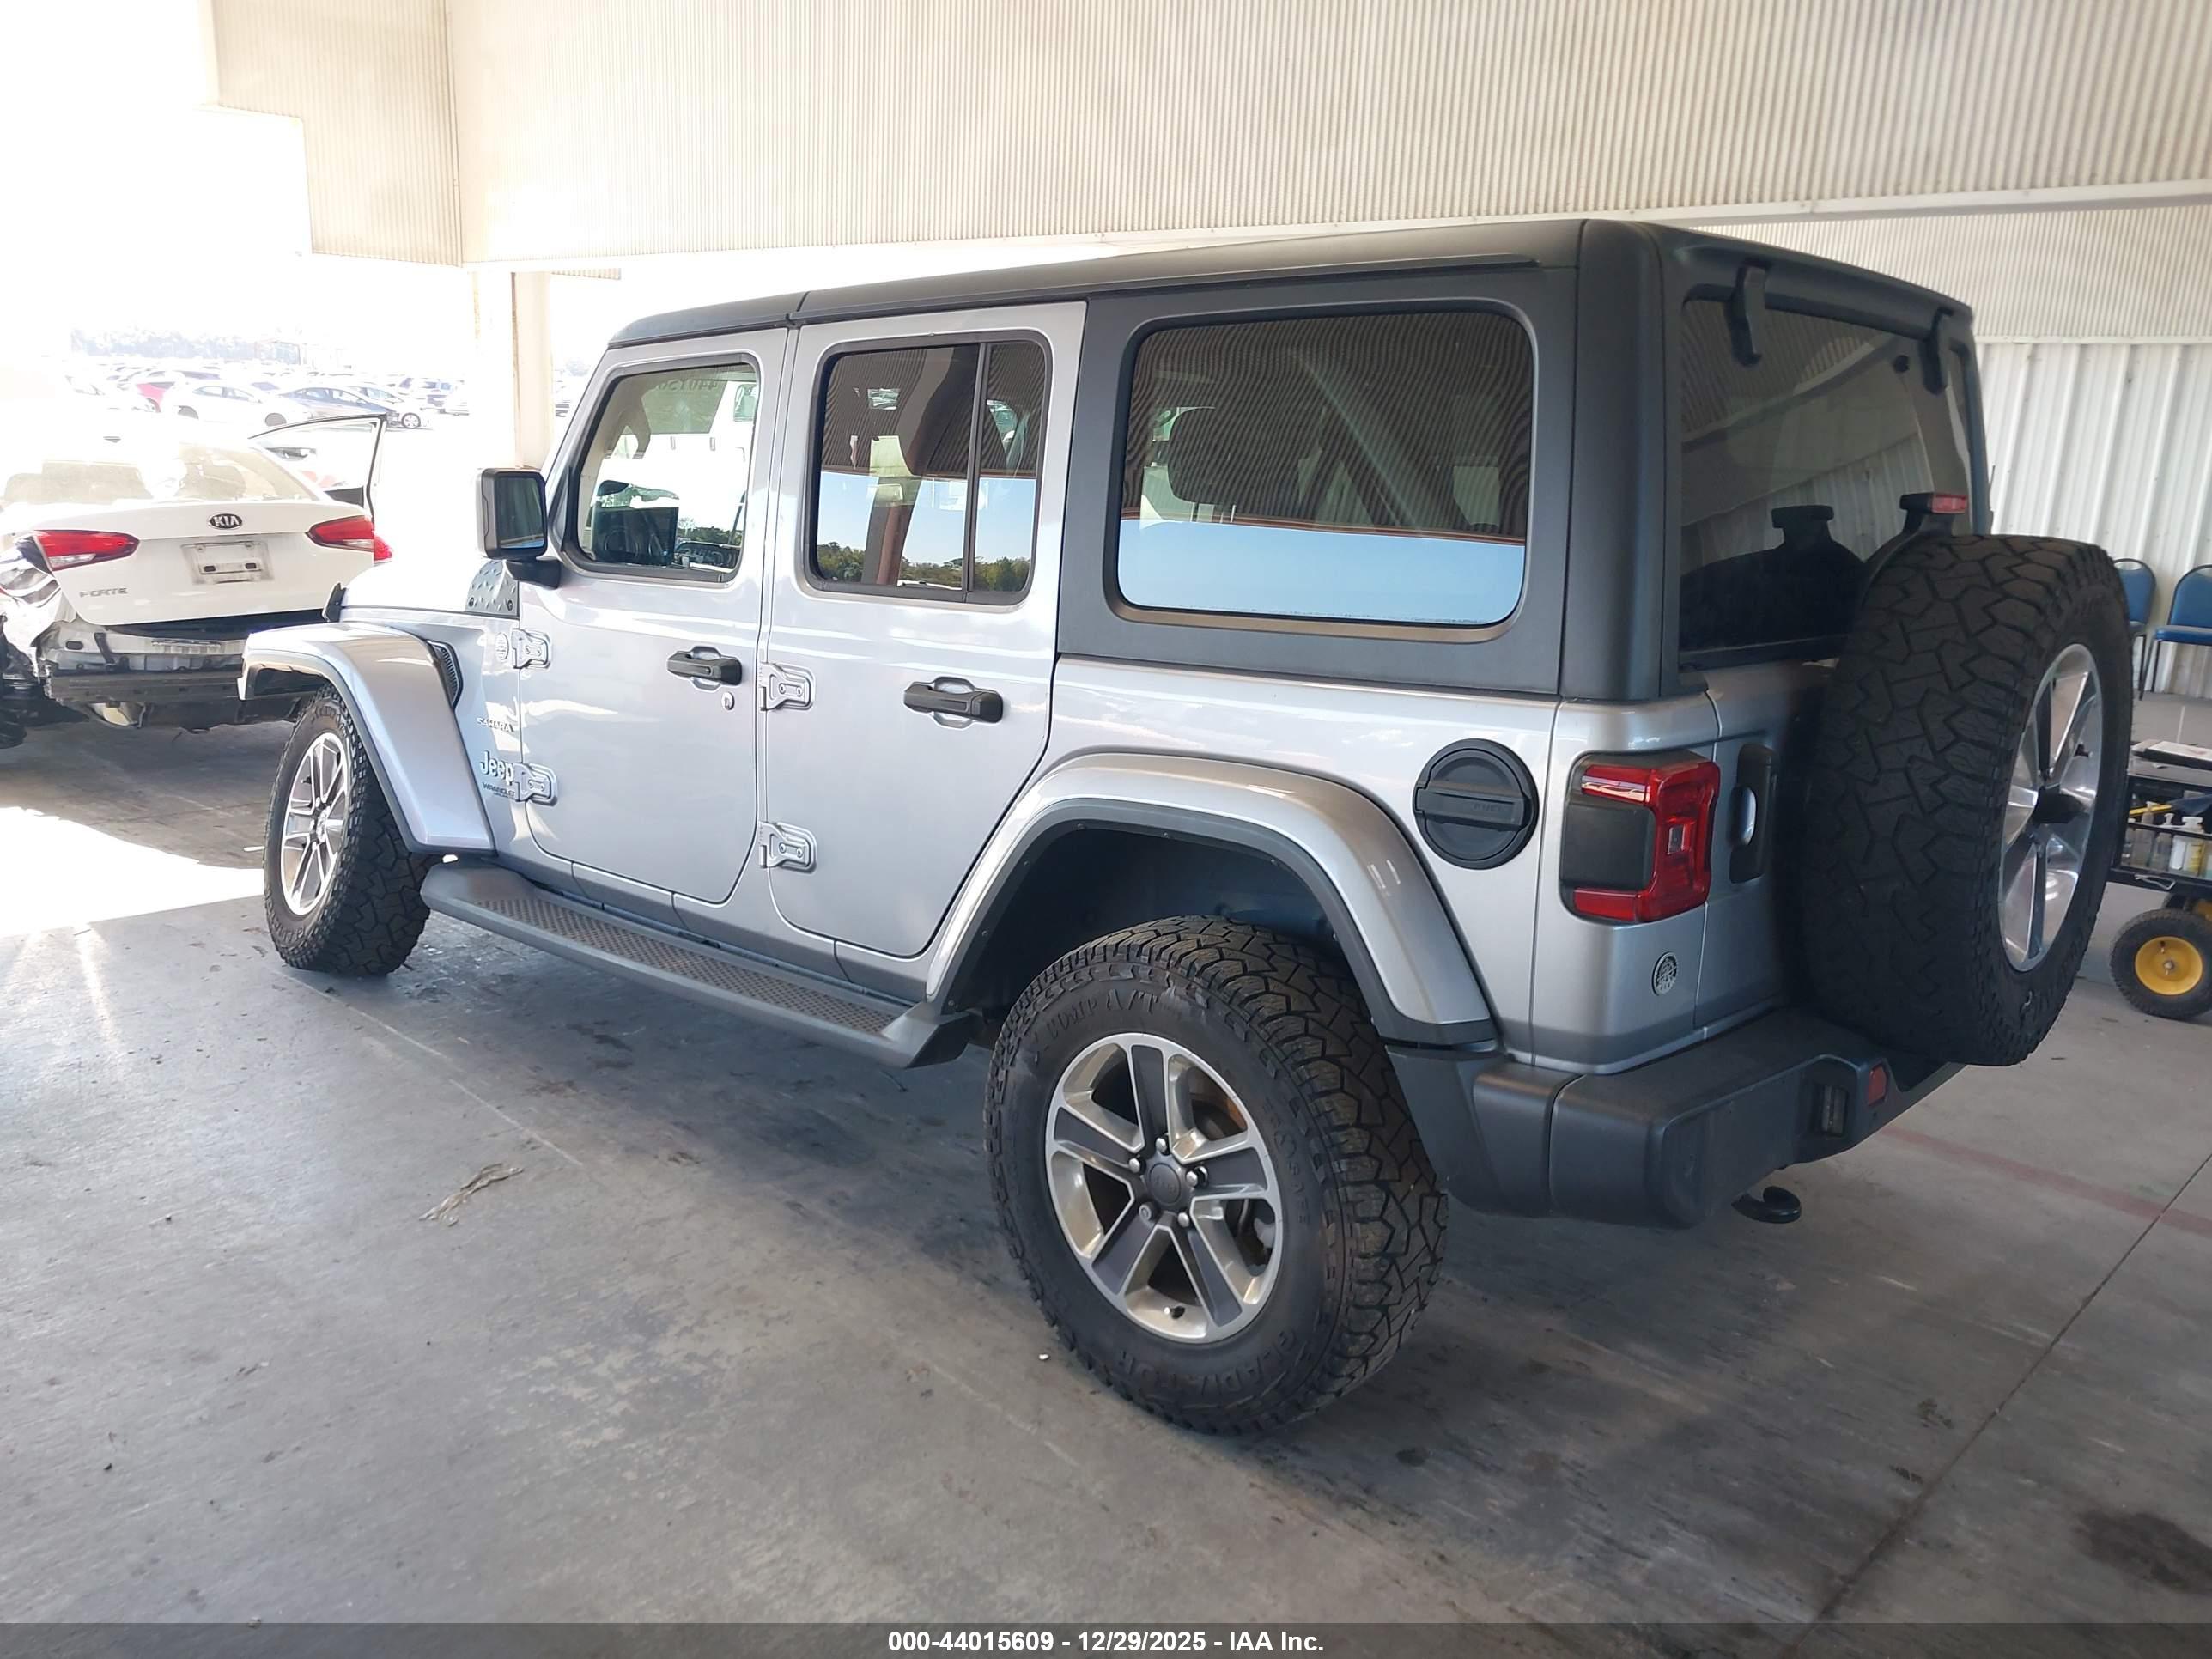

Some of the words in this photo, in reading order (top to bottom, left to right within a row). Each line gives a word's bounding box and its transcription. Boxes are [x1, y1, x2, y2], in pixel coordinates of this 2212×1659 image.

[213, 515, 240, 527] KIA
[80, 587, 129, 598] FORTE
[477, 717, 514, 732] SAHARA
[480, 750, 515, 785] Jeep
